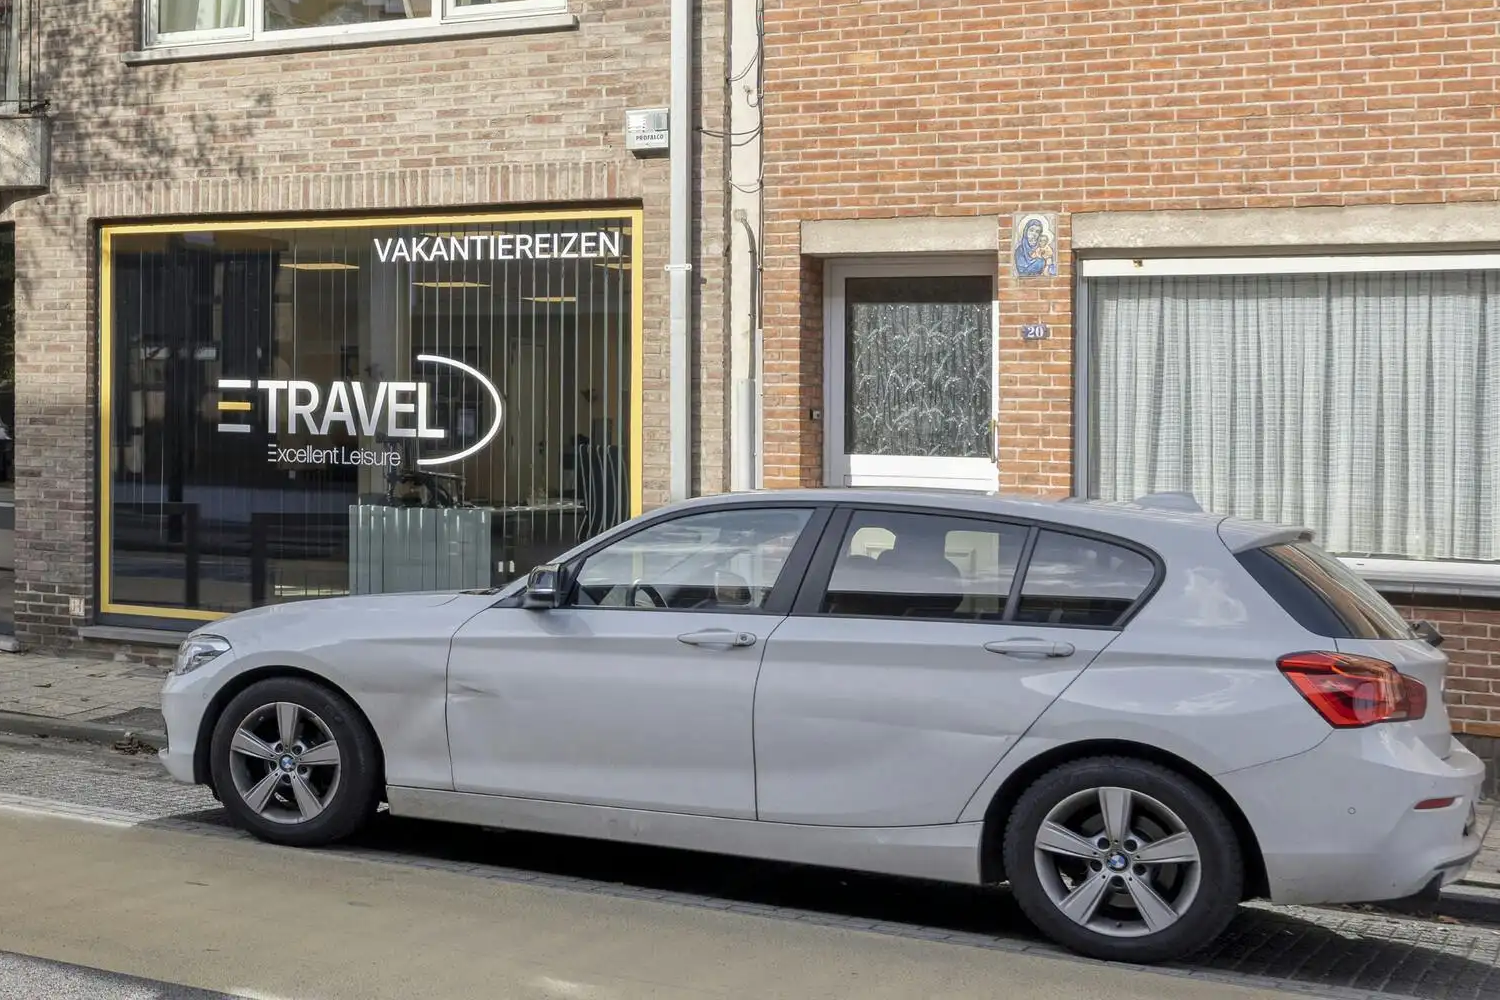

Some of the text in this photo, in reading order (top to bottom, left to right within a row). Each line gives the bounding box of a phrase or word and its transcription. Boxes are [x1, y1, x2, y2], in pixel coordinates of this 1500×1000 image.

[374, 232, 621, 263] VAKANTIEREIZEN
[1027, 326, 1044, 338] 20
[267, 443, 401, 467] Excellent Leisure
